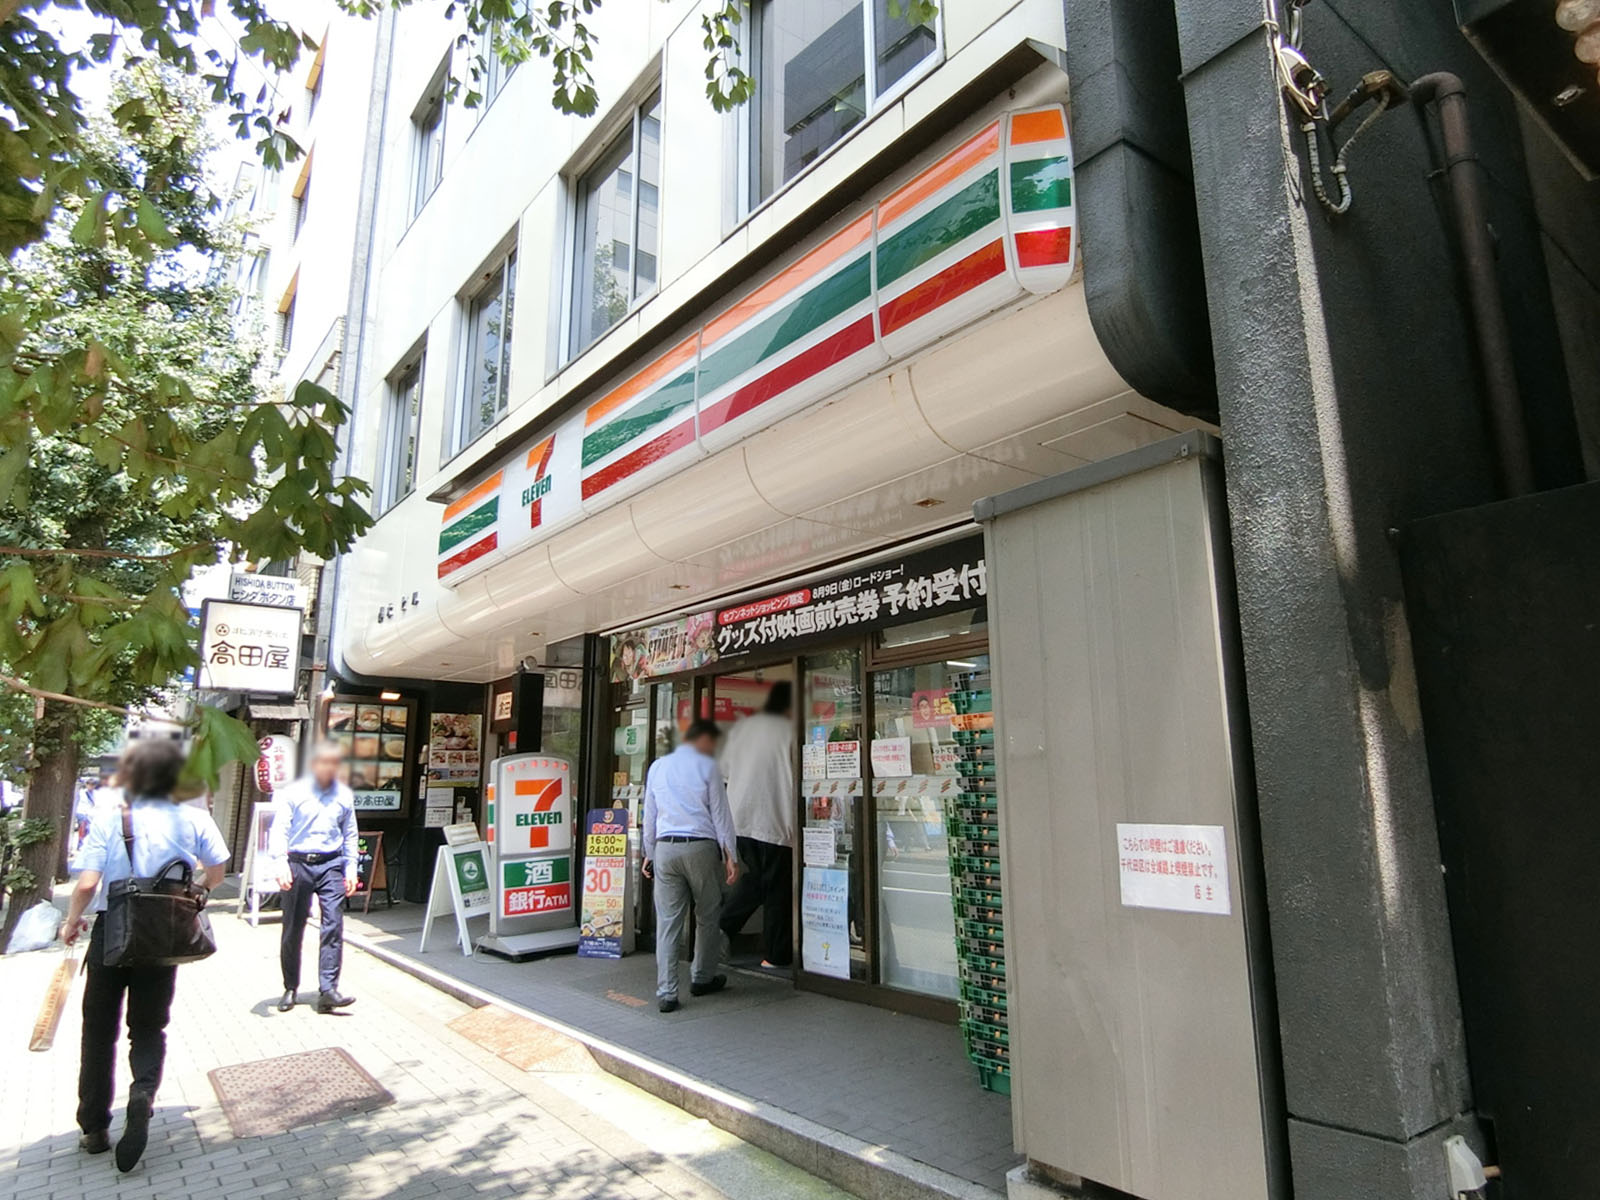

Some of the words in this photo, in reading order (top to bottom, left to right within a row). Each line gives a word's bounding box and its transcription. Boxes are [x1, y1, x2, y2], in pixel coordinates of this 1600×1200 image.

[235, 577, 266, 590] HISHIDA
[267, 580, 295, 592] BUTTON
[210, 640, 290, 670] 高田屋
[525, 860, 554, 886] 酒
